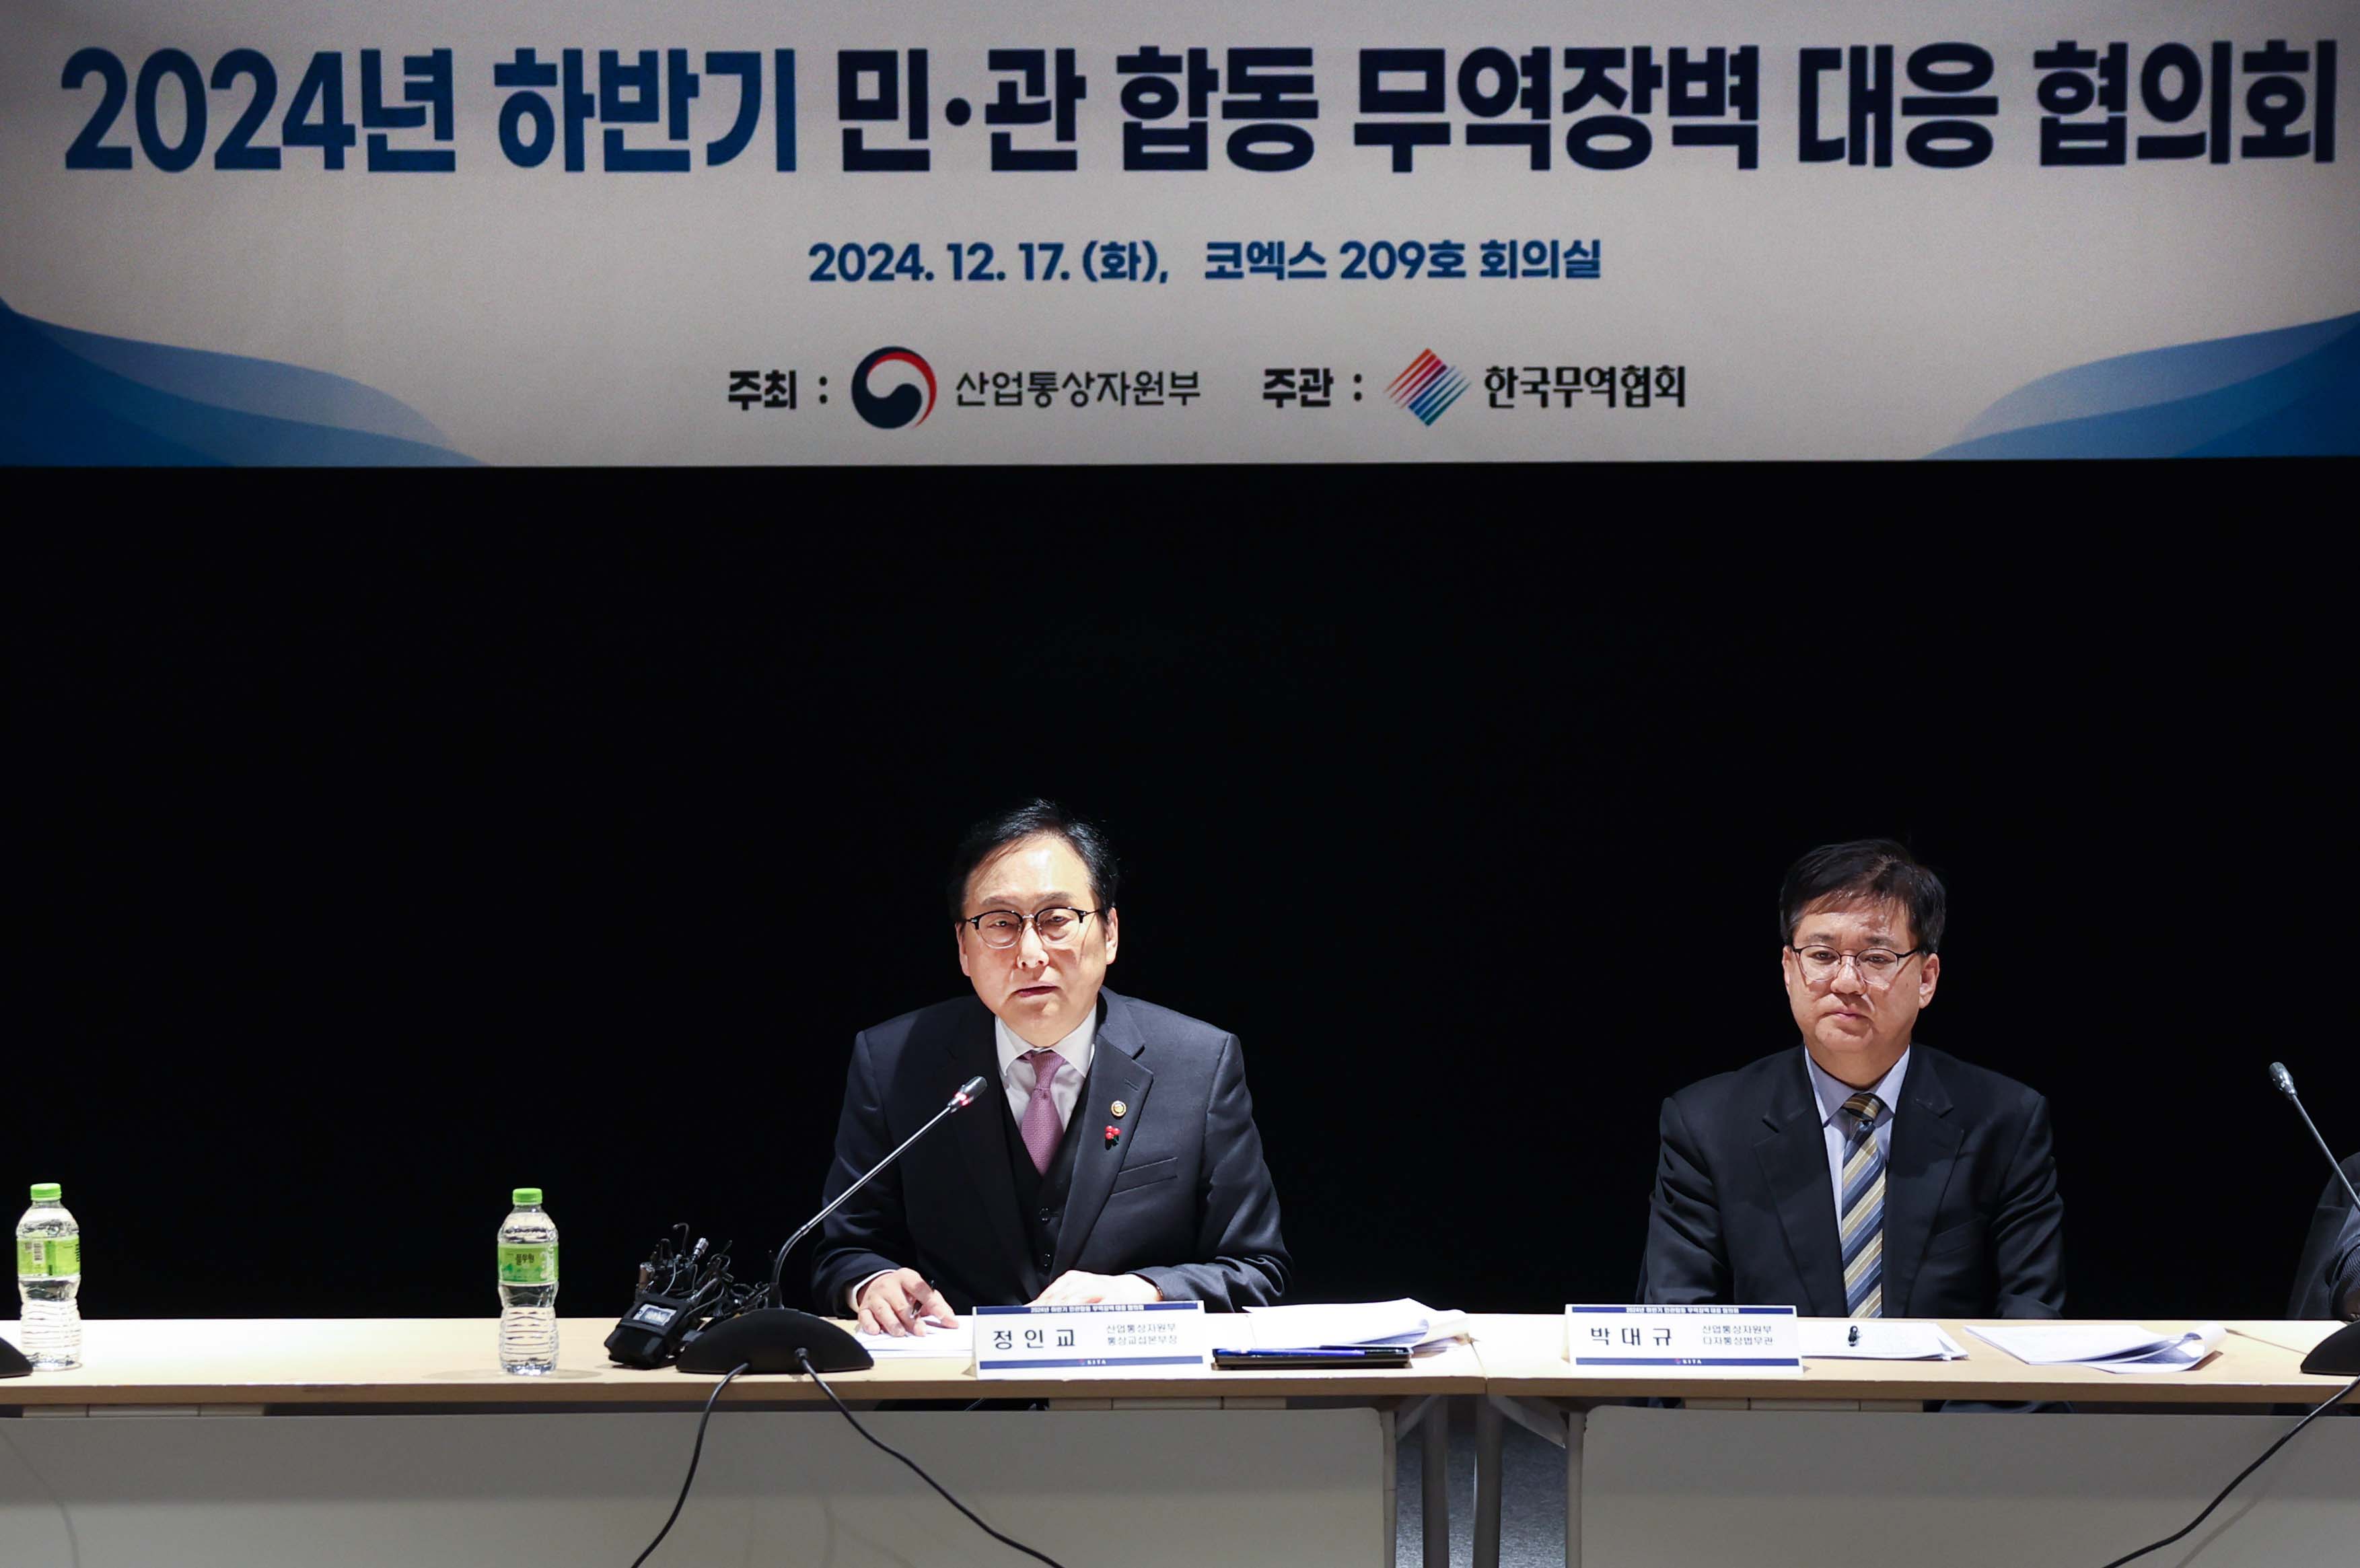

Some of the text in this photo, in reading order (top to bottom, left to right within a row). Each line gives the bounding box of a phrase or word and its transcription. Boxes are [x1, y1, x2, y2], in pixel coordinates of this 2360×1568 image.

[61, 46, 456, 173] 2024년
[493, 46, 797, 174] 하반기
[1116, 46, 1320, 172] 합동
[1353, 44, 1760, 173] 무역장벽
[1798, 42, 1999, 169] 대응
[2032, 39, 2337, 167] 협의회
[808, 239, 1601, 284] 2024. 12. 17. (화), 코엑스 209호 회의실
[956, 370, 1201, 408] 산업통상자원부
[1485, 365, 1685, 408] 한국무역협회
[1106, 1323, 1176, 1334] 산업통상자원부
[1703, 1325, 1772, 1334] 산업통상자원부
